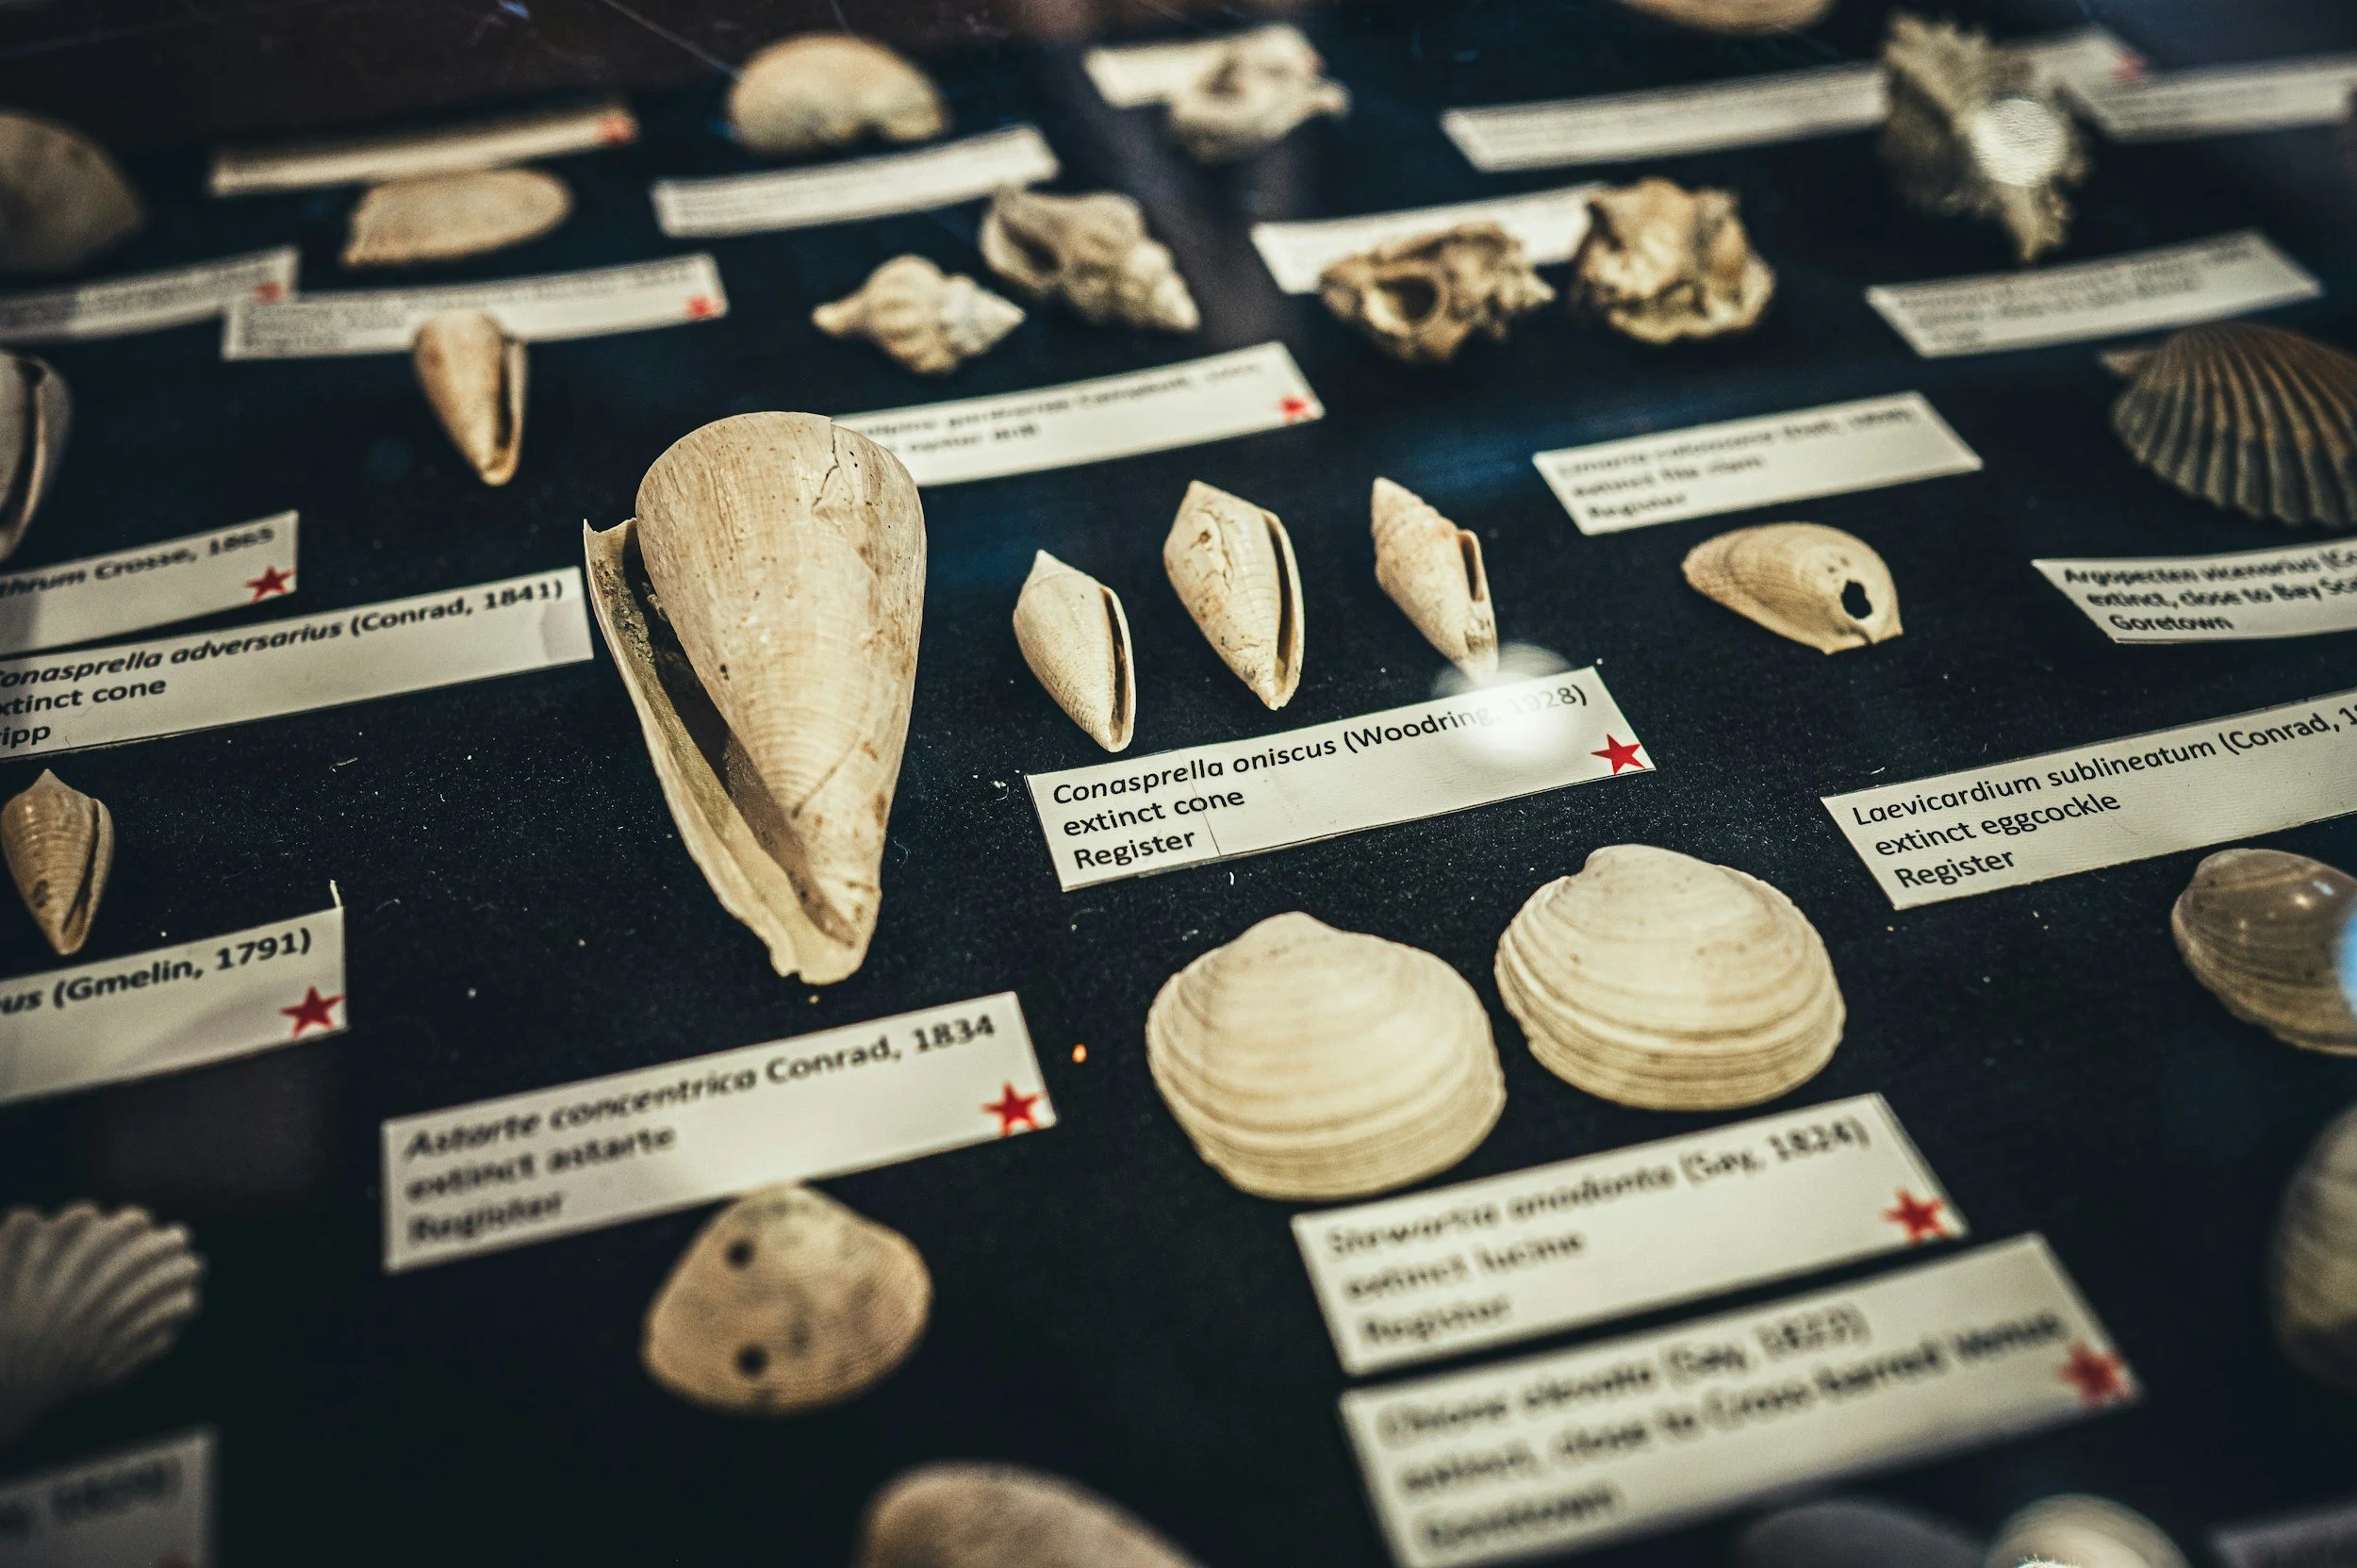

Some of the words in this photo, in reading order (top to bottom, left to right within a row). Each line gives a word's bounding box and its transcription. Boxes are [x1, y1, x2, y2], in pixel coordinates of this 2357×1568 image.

[2086, 591, 2179, 610] extinct,
[2241, 586, 2272, 603] to
[0, 651, 163, 687] onasprella
[170, 621, 344, 664] adversarius
[351, 596, 474, 638] (Conrad,
[484, 578, 564, 611] 1841)
[2109, 614, 2234, 631] Goretown
[92, 679, 167, 704] cone
[0, 724, 51, 750] ipp
[1053, 759, 1224, 805] Conasprella
[1232, 739, 1337, 773] oniscus
[1852, 773, 2043, 826] Laevicardium
[2046, 738, 2217, 788] sublineatum
[2217, 712, 2340, 756] (Conrad,
[1063, 802, 1166, 836] extinct
[1173, 790, 1245, 816] cone
[1874, 821, 1977, 857] extinct
[1981, 790, 2122, 836] eggcockle
[1073, 830, 1195, 869] Register
[1893, 848, 2017, 889] Register
[53, 960, 205, 1009] (Gmelin,
[215, 927, 312, 972] 1791)
[404, 1113, 541, 1161] Astarte
[550, 1067, 757, 1131] concentrica
[765, 1033, 902, 1085] Conrad,
[910, 1014, 996, 1053] 1834
[404, 1152, 536, 1203] extinct
[547, 1127, 676, 1175] astarte
[1343, 1255, 1468, 1300] extinct
